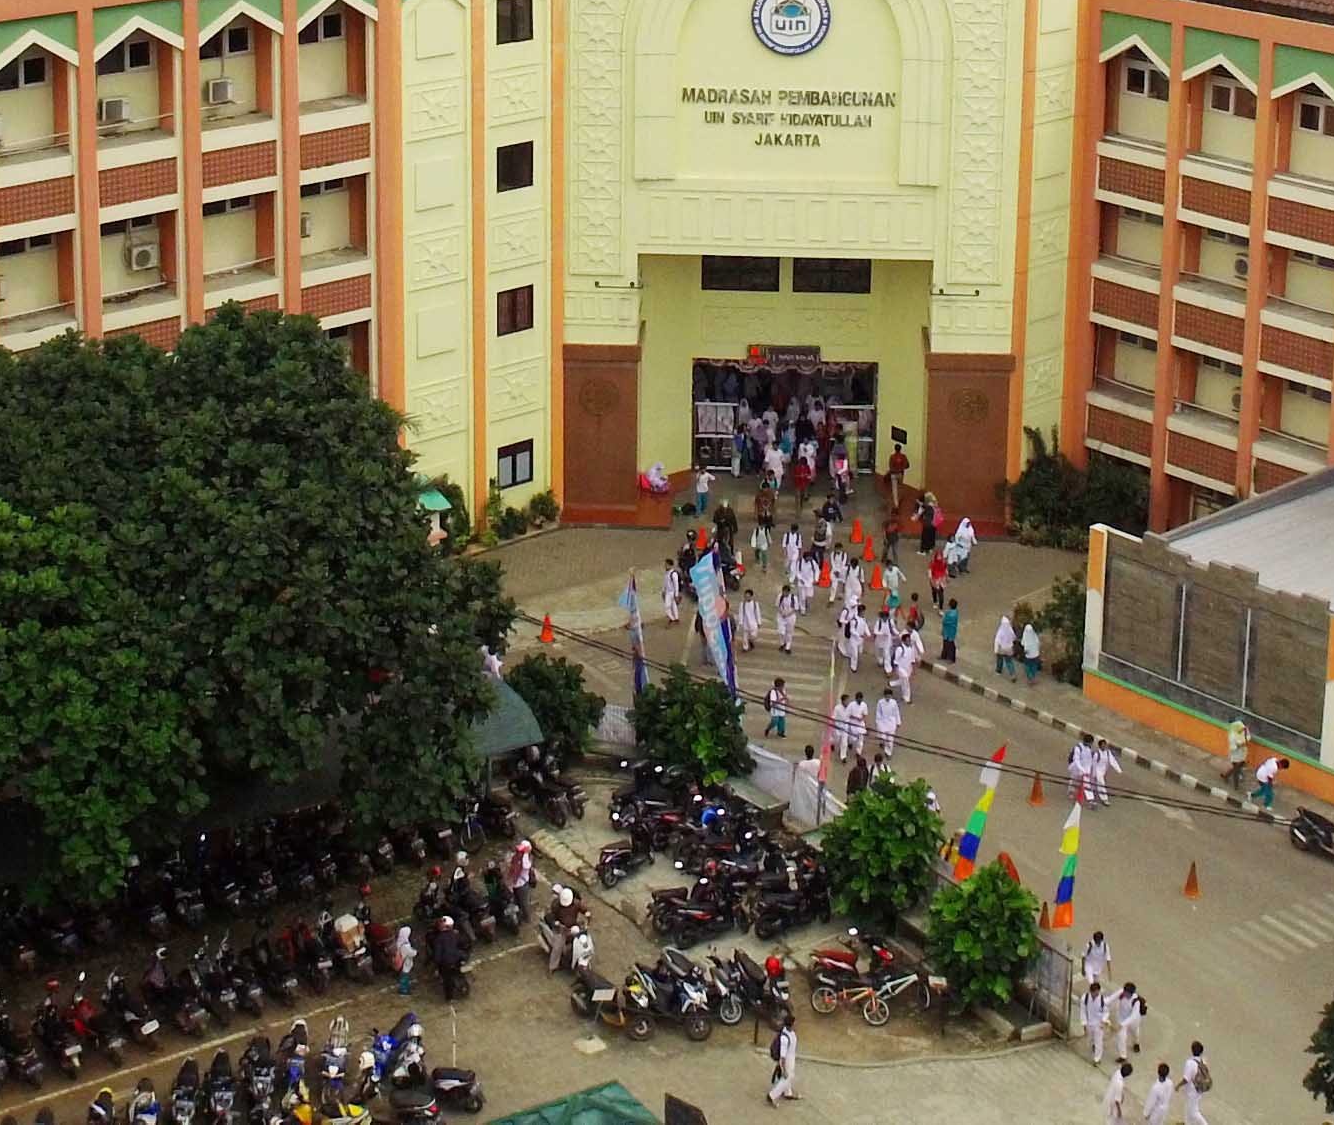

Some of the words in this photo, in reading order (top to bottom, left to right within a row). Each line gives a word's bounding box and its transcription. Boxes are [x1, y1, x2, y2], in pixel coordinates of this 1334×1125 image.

[681, 87, 772, 106] MADRASAH
[778, 89, 897, 108] PEMBANGUNAN
[704, 111, 725, 124] UIN
[732, 112, 775, 125] SYARIF
[780, 113, 872, 128] HIDAYATULLAH
[754, 133, 821, 147] JAKARTA
